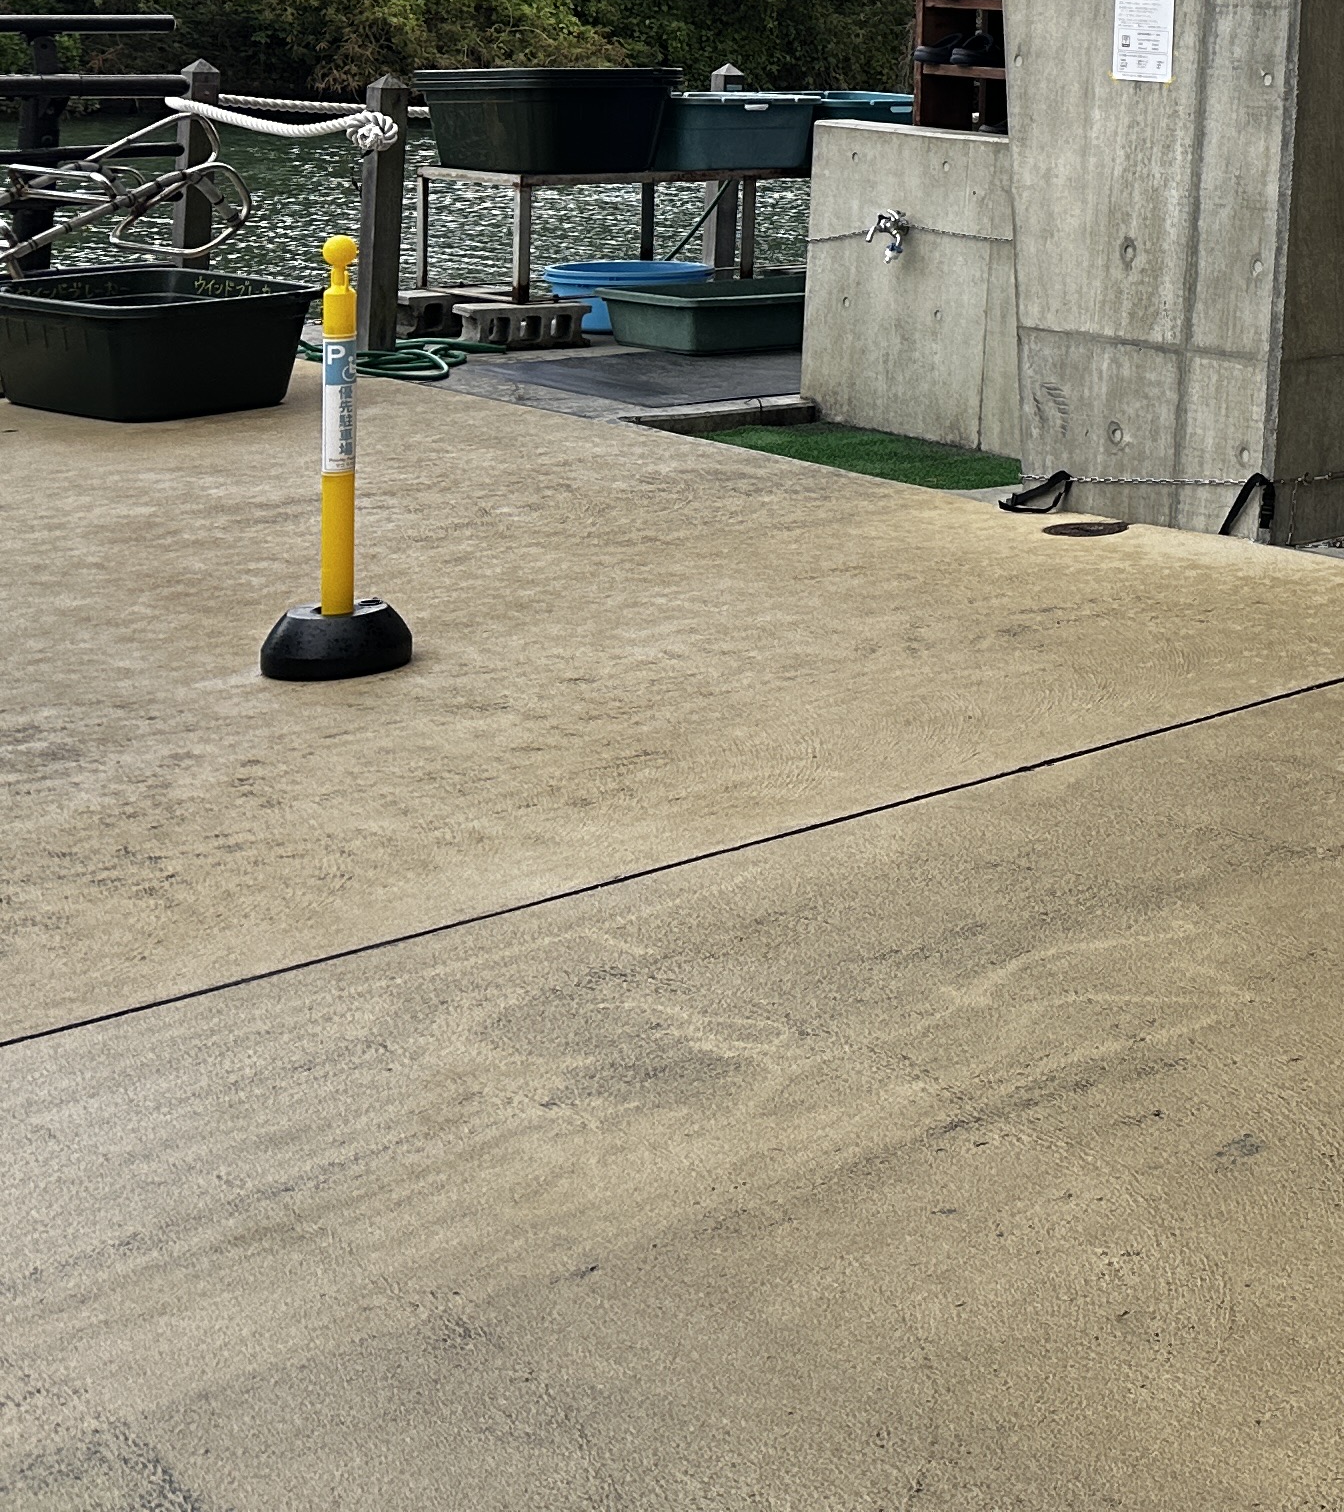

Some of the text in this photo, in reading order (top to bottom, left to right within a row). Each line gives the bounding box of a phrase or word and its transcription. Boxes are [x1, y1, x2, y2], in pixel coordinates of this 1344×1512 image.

[327, 345, 346, 366] P
[338, 385, 353, 457] 優先駐車場
